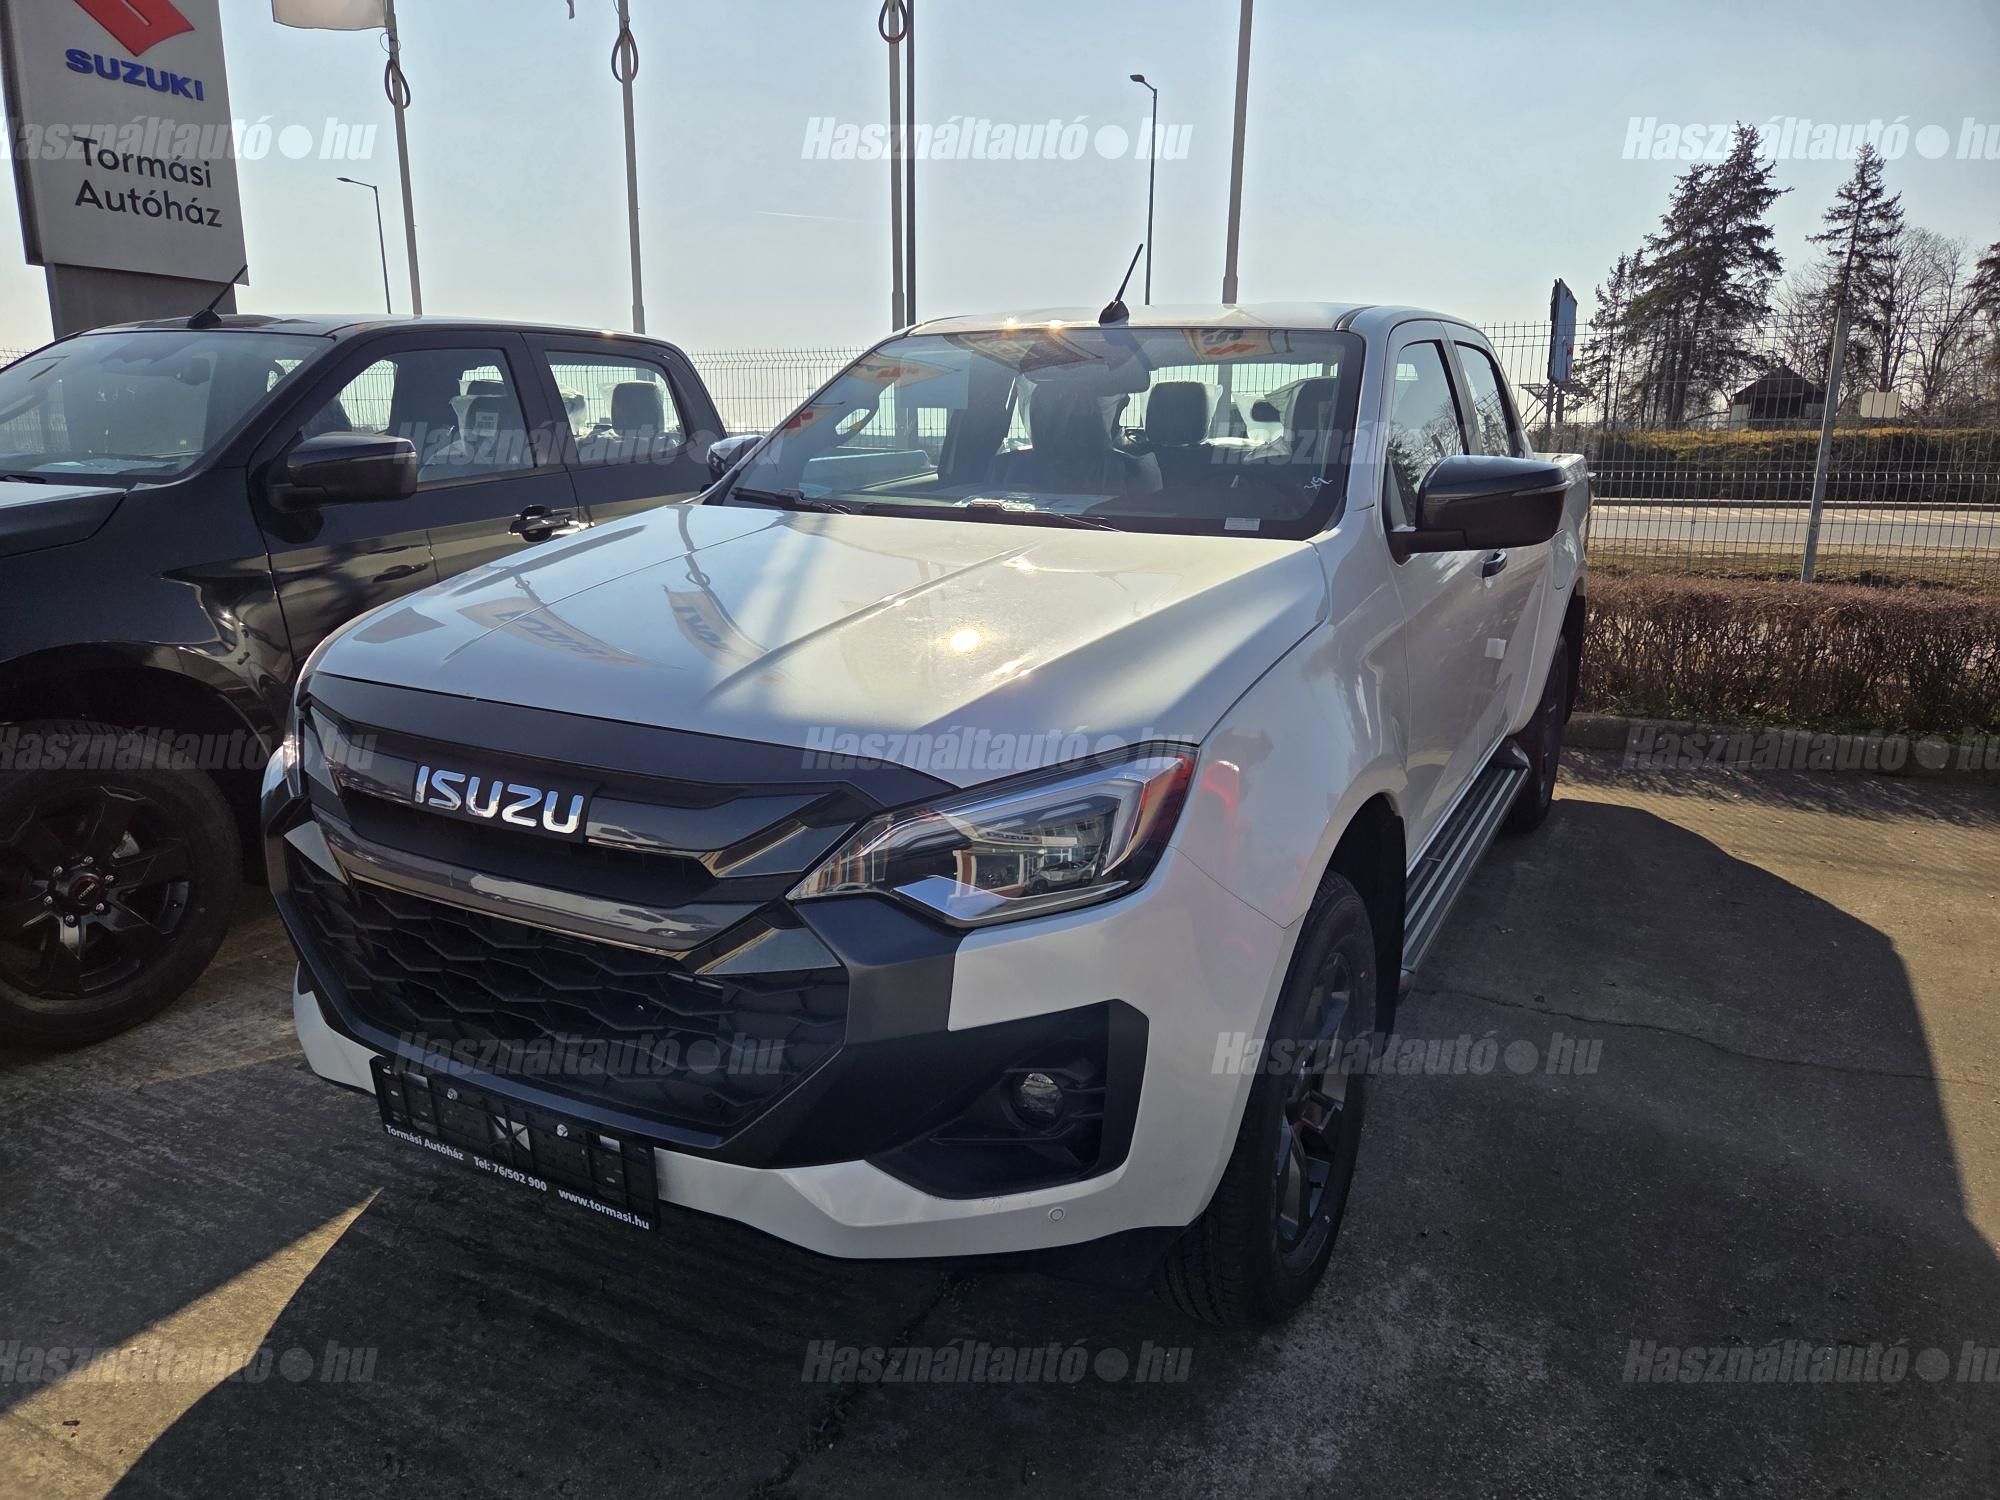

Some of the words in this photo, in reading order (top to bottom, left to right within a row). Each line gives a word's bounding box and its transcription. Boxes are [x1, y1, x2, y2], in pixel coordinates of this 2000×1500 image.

[65, 48, 204, 101] SUZUKI
[73, 135, 211, 188] Tormási
[75, 179, 223, 228] Autóház
[414, 765, 585, 834] ISUZU
[385, 1124, 422, 1145] Tormási
[424, 1138, 464, 1161] Autóház
[473, 1155, 491, 1171] Tel:
[492, 1163, 526, 1184] 76/502
[527, 1176, 548, 1192] 900
[558, 1189, 650, 1231] www.tormasi.hu
